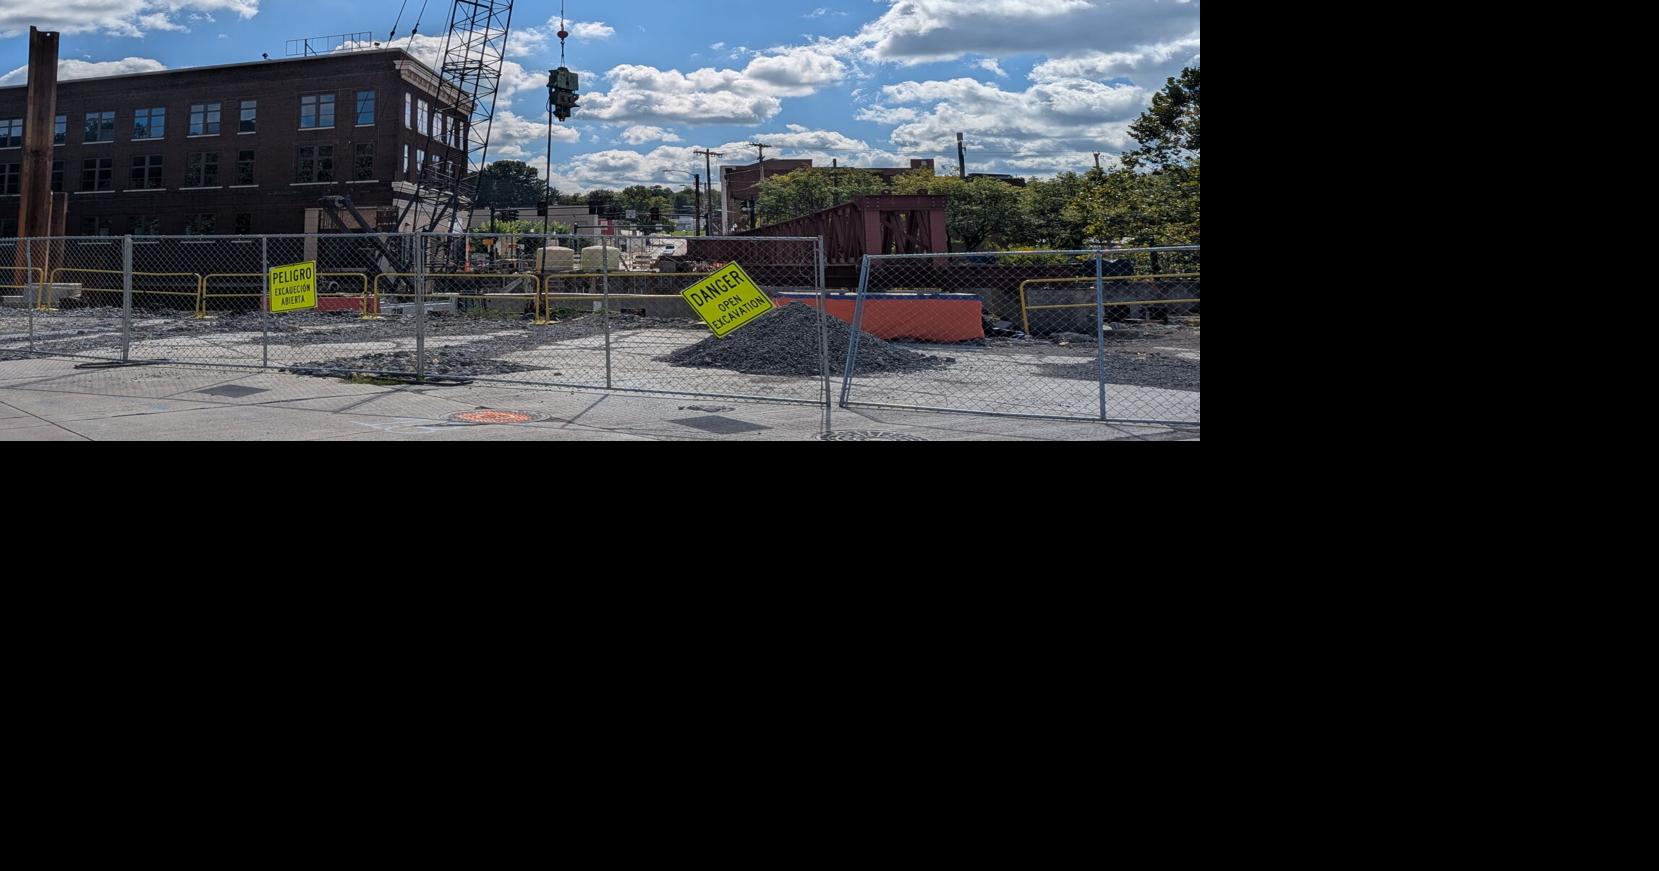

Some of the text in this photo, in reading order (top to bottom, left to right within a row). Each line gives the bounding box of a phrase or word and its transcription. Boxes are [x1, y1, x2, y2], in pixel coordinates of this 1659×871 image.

[272, 267, 312, 285] PELIGRO
[690, 270, 745, 307] DANGER
[281, 295, 306, 306] ABIERTA
[718, 294, 743, 312] OPEN
[711, 296, 766, 330] EXCAVATION
